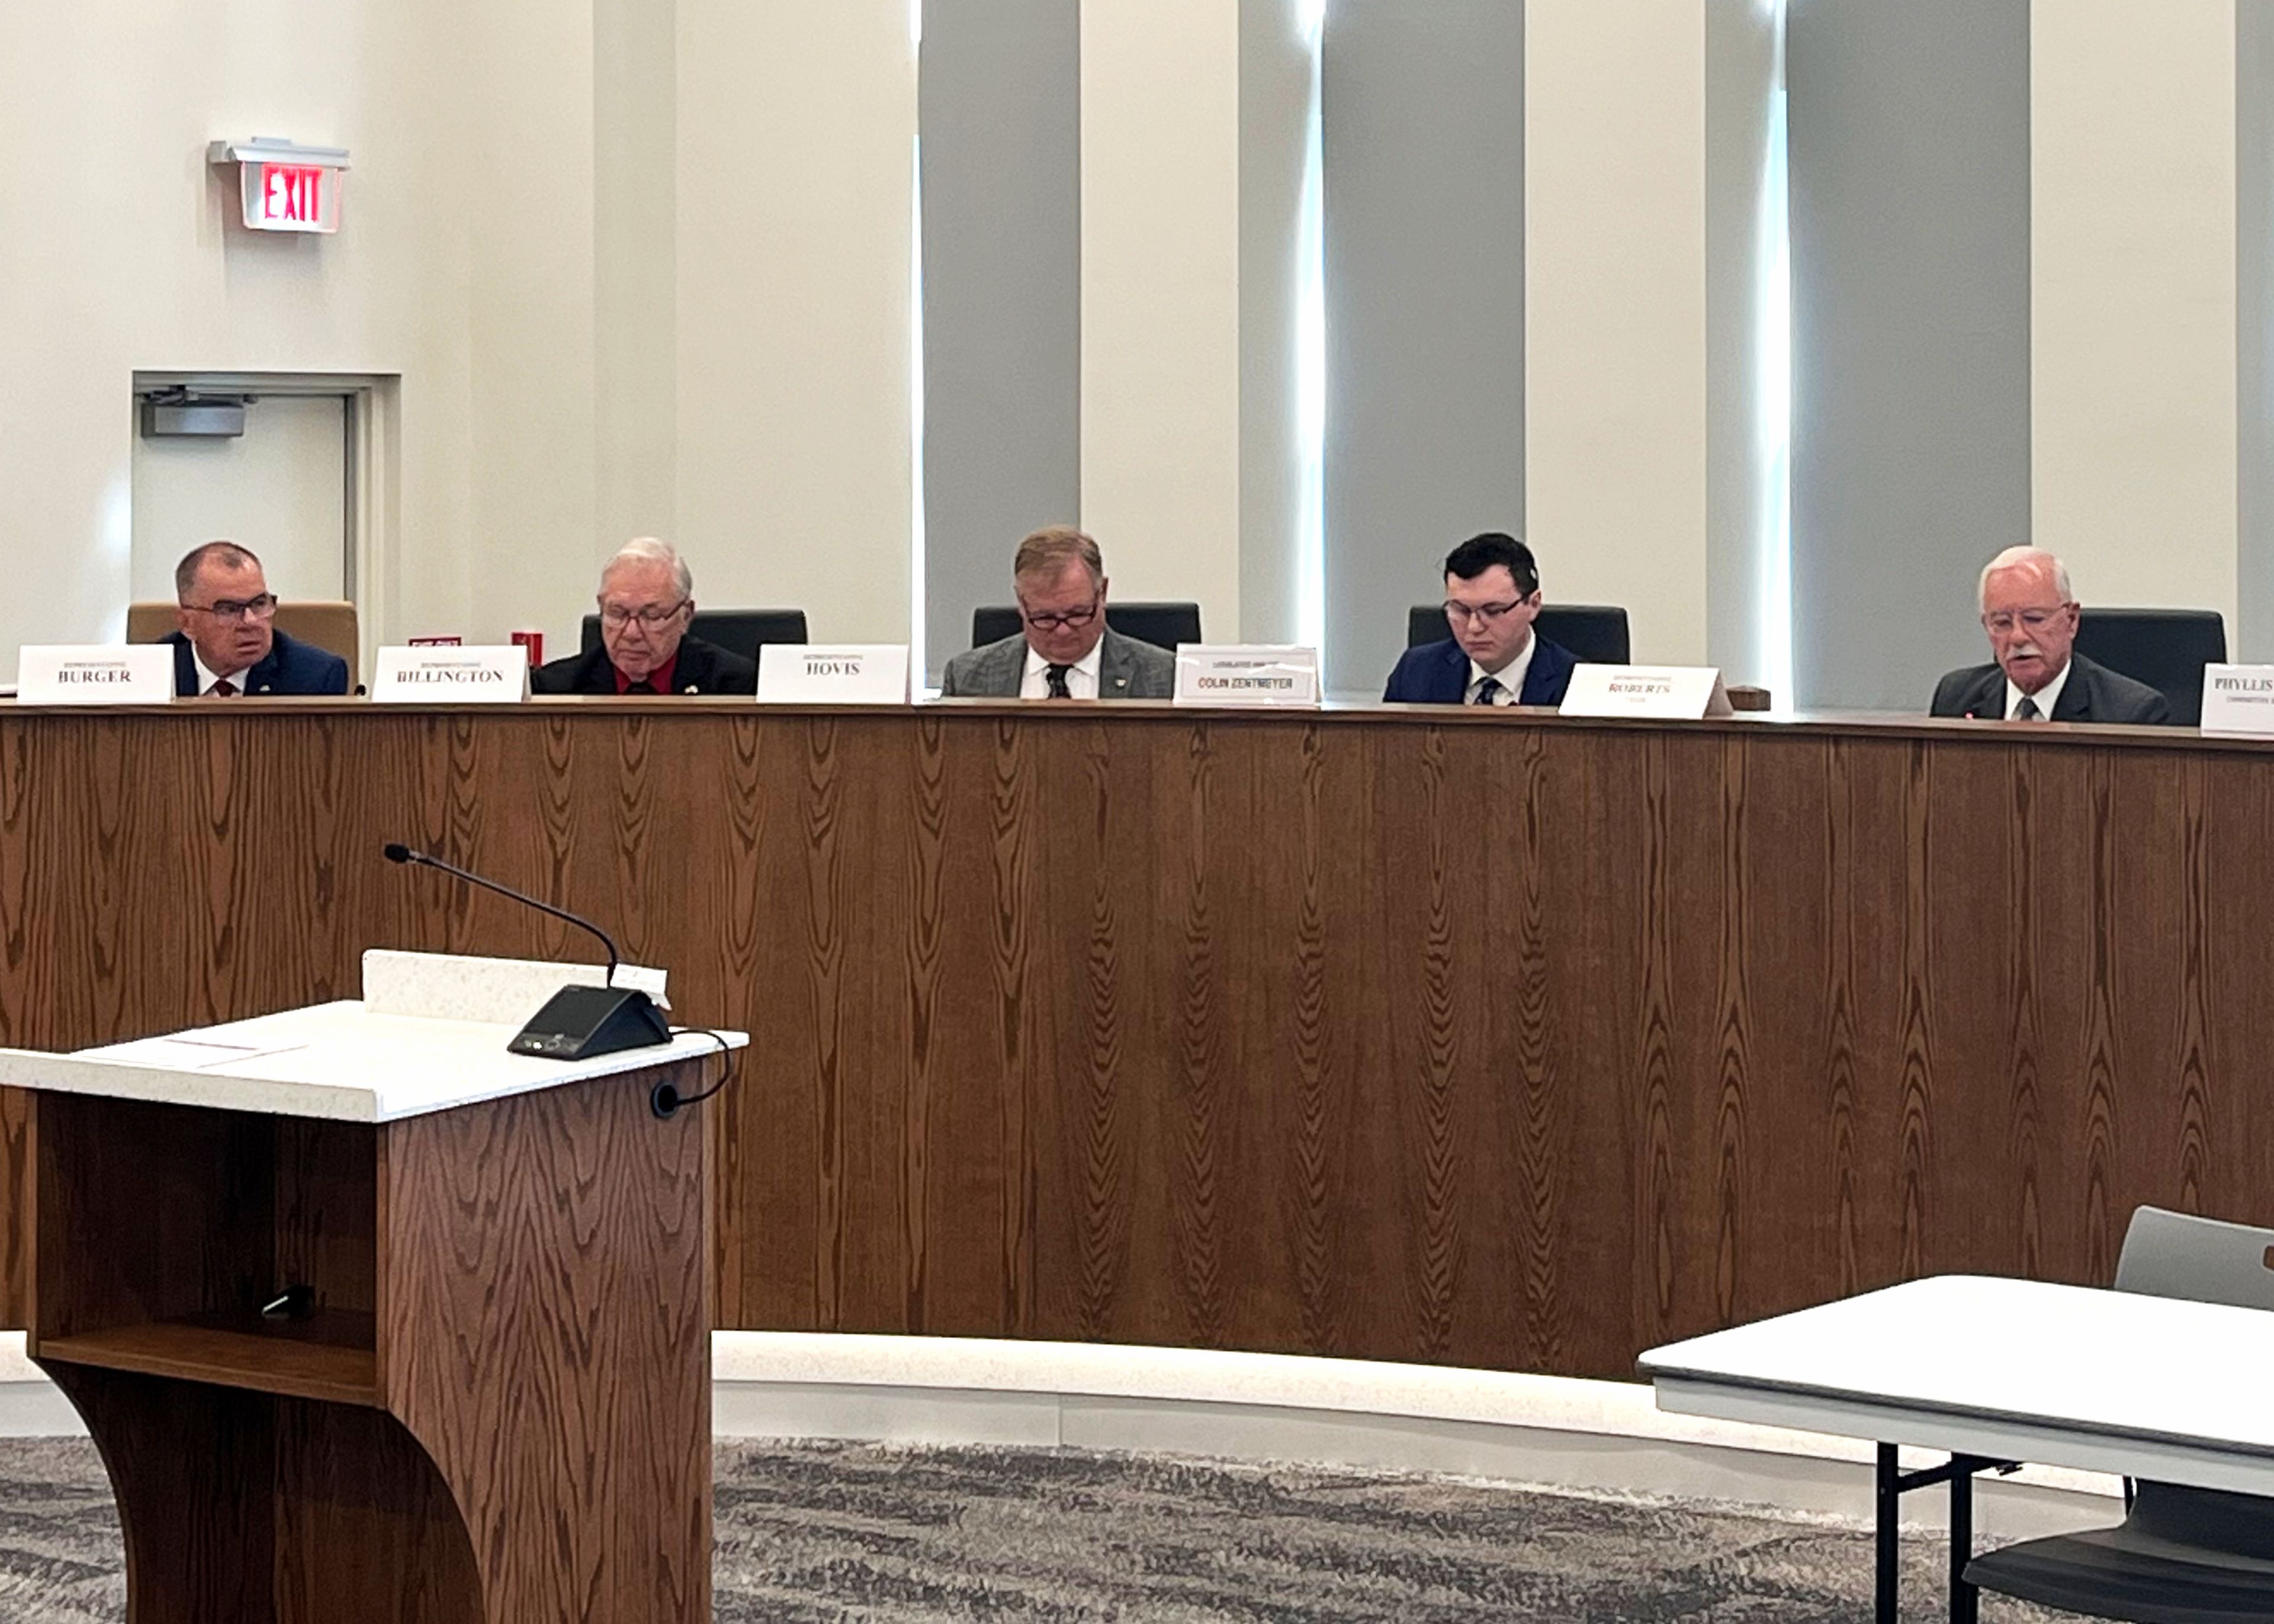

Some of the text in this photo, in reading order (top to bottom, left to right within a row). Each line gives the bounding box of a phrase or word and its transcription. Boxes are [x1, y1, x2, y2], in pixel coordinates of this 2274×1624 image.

[264, 168, 323, 221] EXIT
[807, 663, 860, 676] HOVIS
[58, 670, 132, 683] BURGER
[397, 671, 503, 683] BILLINGTON
[1199, 677, 1229, 689] COLIN
[2215, 678, 2273, 691] PHYLLIS
